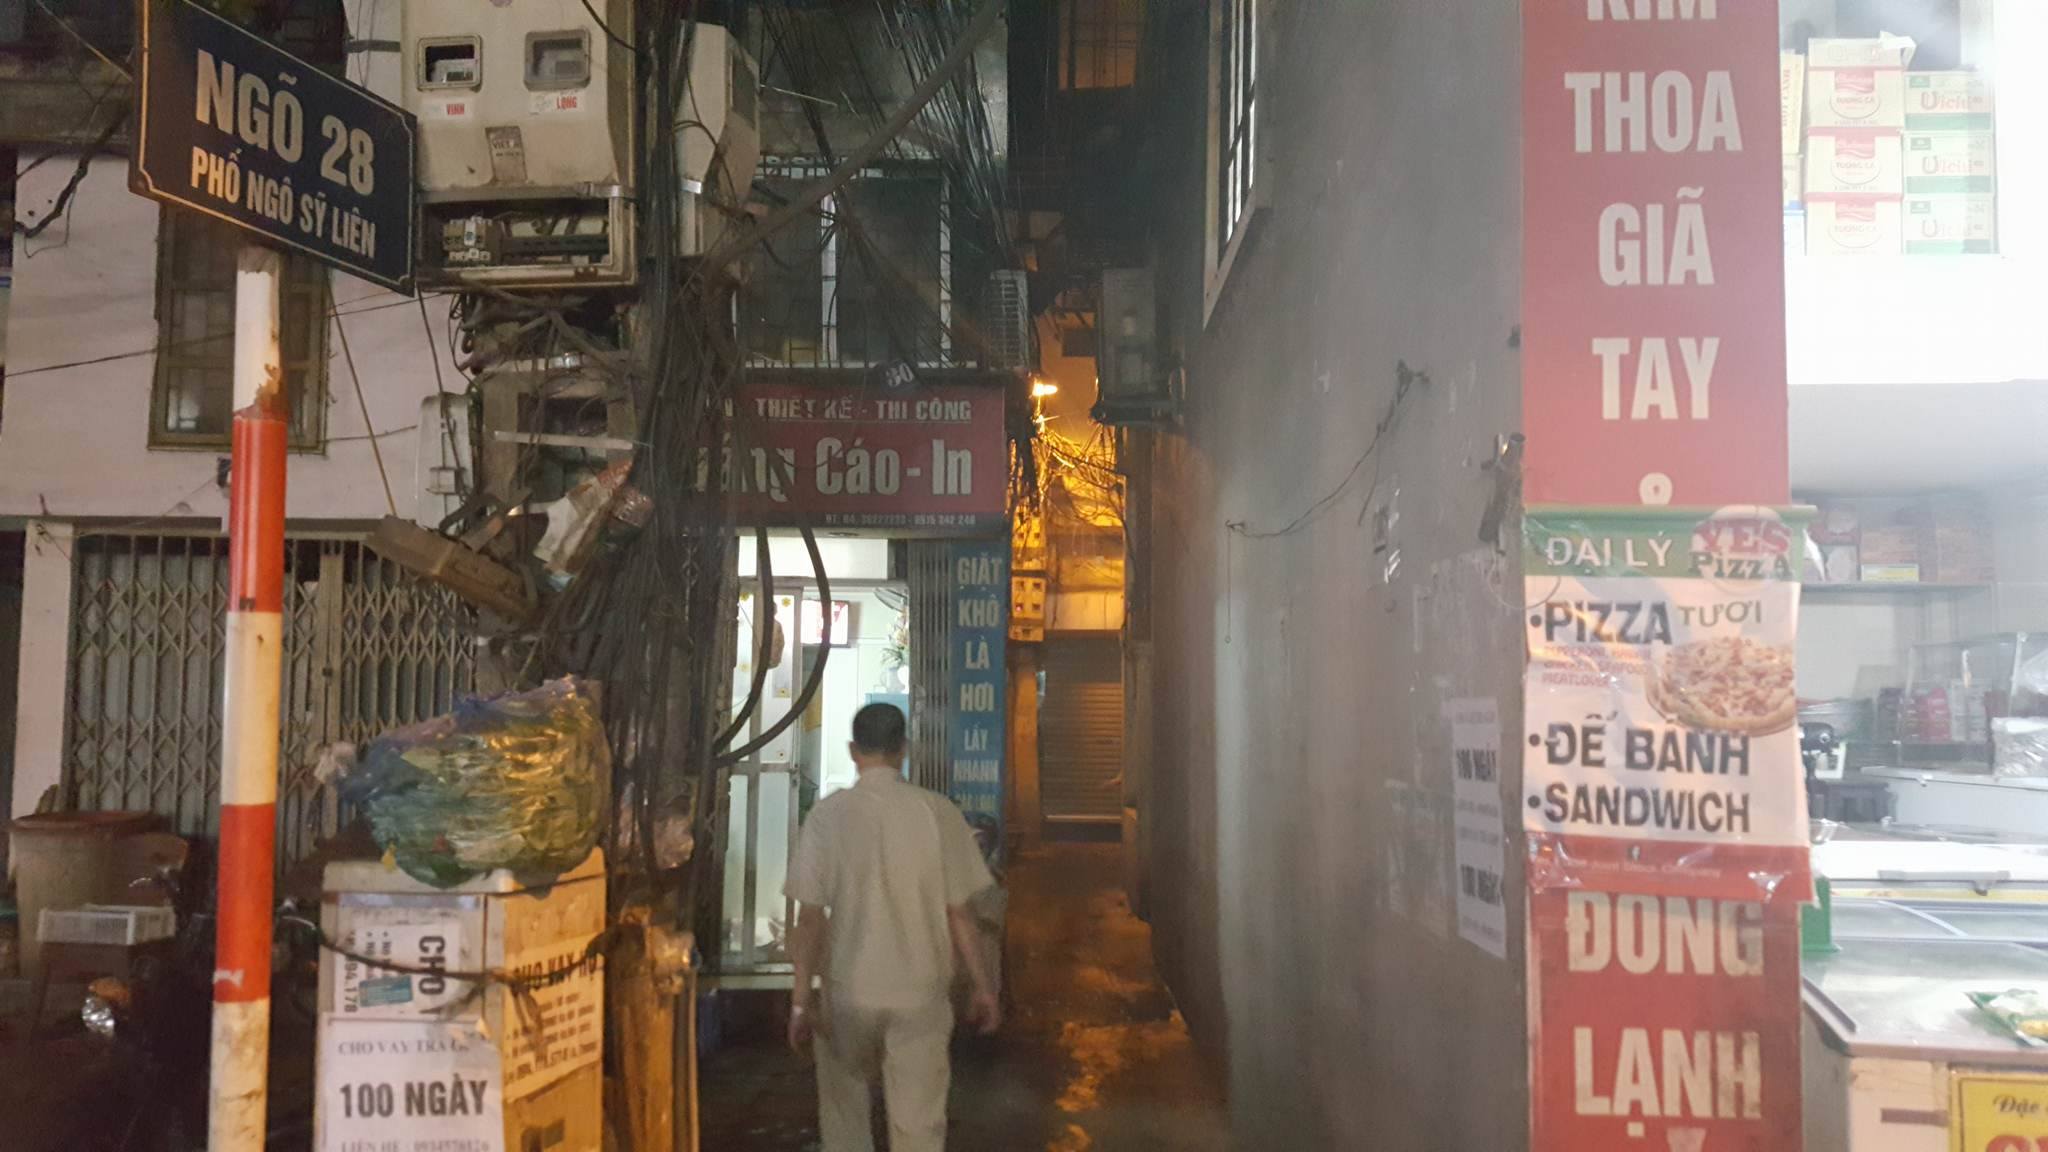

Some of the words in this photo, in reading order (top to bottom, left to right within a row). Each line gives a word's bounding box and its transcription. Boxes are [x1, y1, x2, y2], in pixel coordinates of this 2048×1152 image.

[196, 48, 303, 163] NGÕ
[321, 114, 374, 196] 28
[1564, 71, 1743, 152] THOA
[191, 146, 241, 204] PHỐ
[247, 169, 294, 225] NGÔ
[300, 191, 328, 239] SỸ
[331, 206, 376, 259] LIÊN
[1599, 186, 1715, 286] GIÃ
[1592, 337, 1720, 420] TAY
[877, 400, 907, 420] THI
[916, 397, 972, 421] CÔNG
[815, 437, 900, 496] Cáo
[932, 439, 972, 495] In
[1625, 531, 1672, 567] LÝ
[1693, 517, 1791, 553] YES
[958, 594, 999, 627] KHÔ
[1545, 602, 1672, 645] PIZZA
[1677, 601, 1761, 627] TƯƠI
[964, 635, 990, 669] LÀ
[1545, 711, 1618, 767] ĐẾ
[1544, 782, 1750, 833] SANDWICH
[340, 1083, 393, 1118] 100
[405, 1073, 488, 1117] NGÀY
[1574, 1026, 1761, 1137] LẠNH
